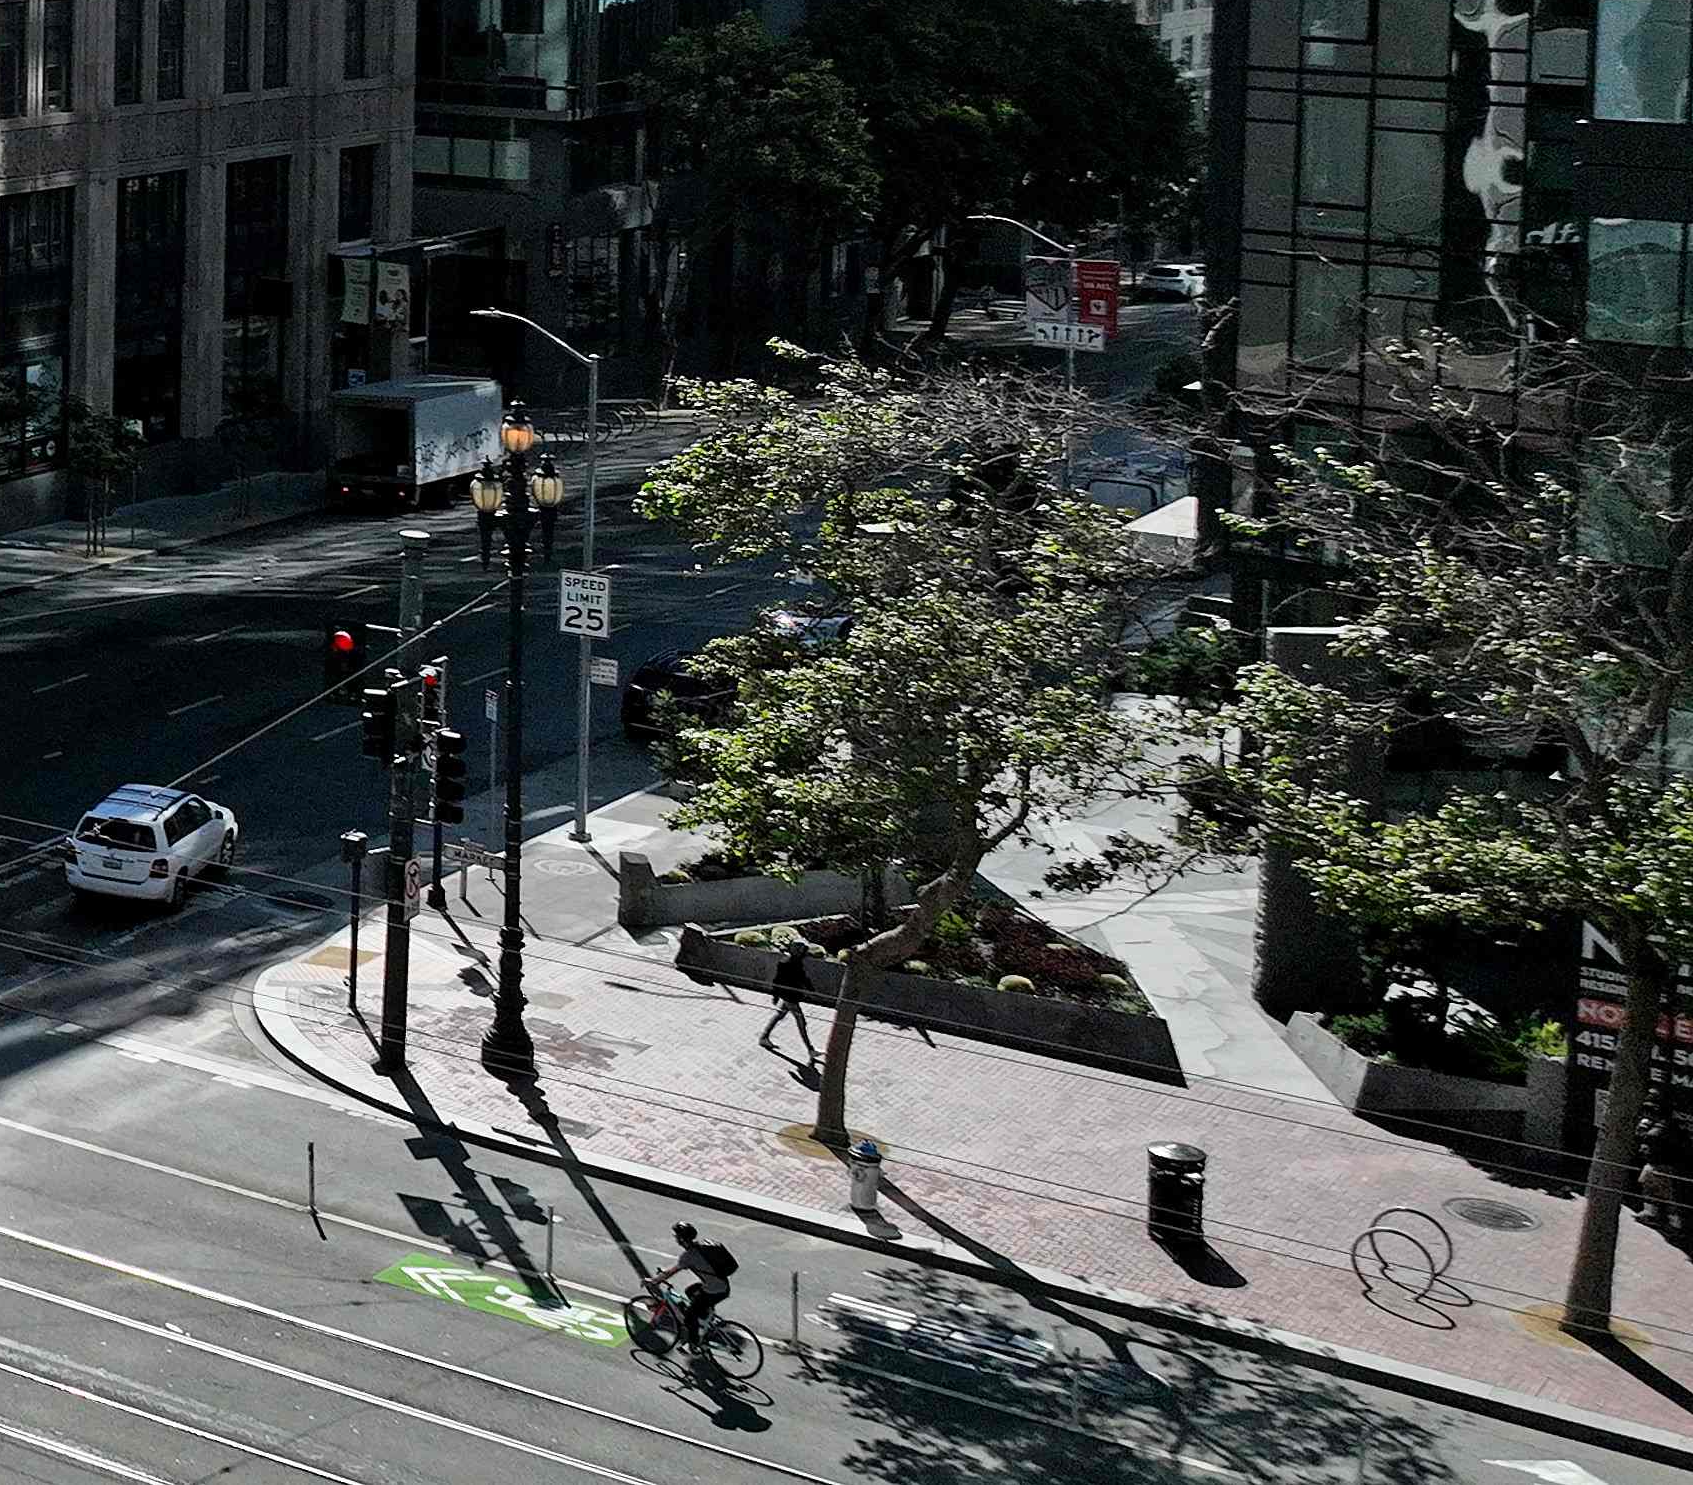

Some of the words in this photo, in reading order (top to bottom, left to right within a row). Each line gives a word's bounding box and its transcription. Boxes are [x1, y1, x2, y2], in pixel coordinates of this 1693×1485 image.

[564, 577, 606, 591] SPEED
[566, 592, 603, 605] LIMIT
[564, 606, 604, 631] 25
